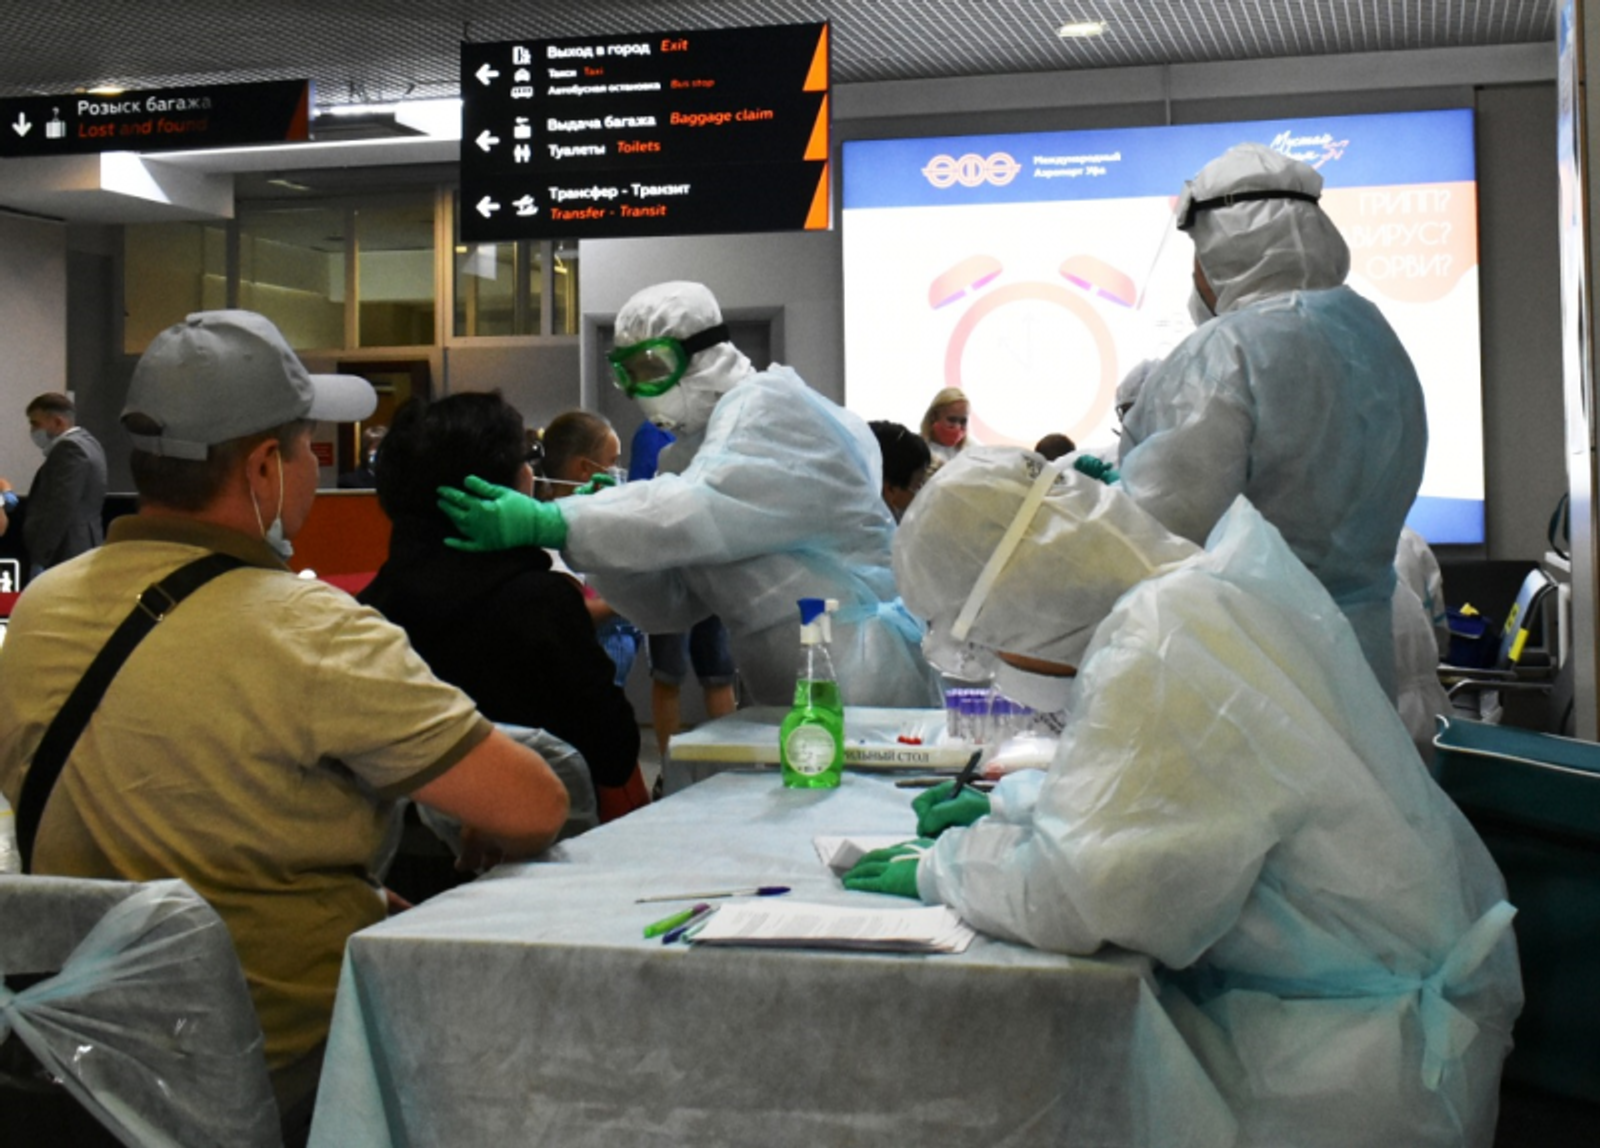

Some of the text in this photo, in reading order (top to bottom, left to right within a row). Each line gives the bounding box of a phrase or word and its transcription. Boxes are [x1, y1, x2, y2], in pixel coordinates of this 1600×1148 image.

[547, 43, 651, 59] Выход в город
[660, 38, 689, 52] Exit
[548, 68, 577, 78] Такси
[583, 66, 604, 76] Taxi
[548, 82, 661, 96] Автобусная остановка
[670, 79, 715, 89] Bus stop
[77, 96, 212, 116] Розыск багажа
[547, 115, 657, 132] Выдача багажа
[670, 107, 773, 126] Baggage claim
[78, 116, 209, 138] Lost and found
[548, 144, 606, 159] Туалеты
[617, 140, 661, 153] Toilets
[548, 185, 619, 203] Трансфер
[630, 183, 691, 199] Транзит
[550, 206, 606, 220] Transfer
[620, 204, 667, 217] Transit
[1366, 254, 1452, 280] ОРВИ?
[897, 752, 929, 763] СТОЛ
